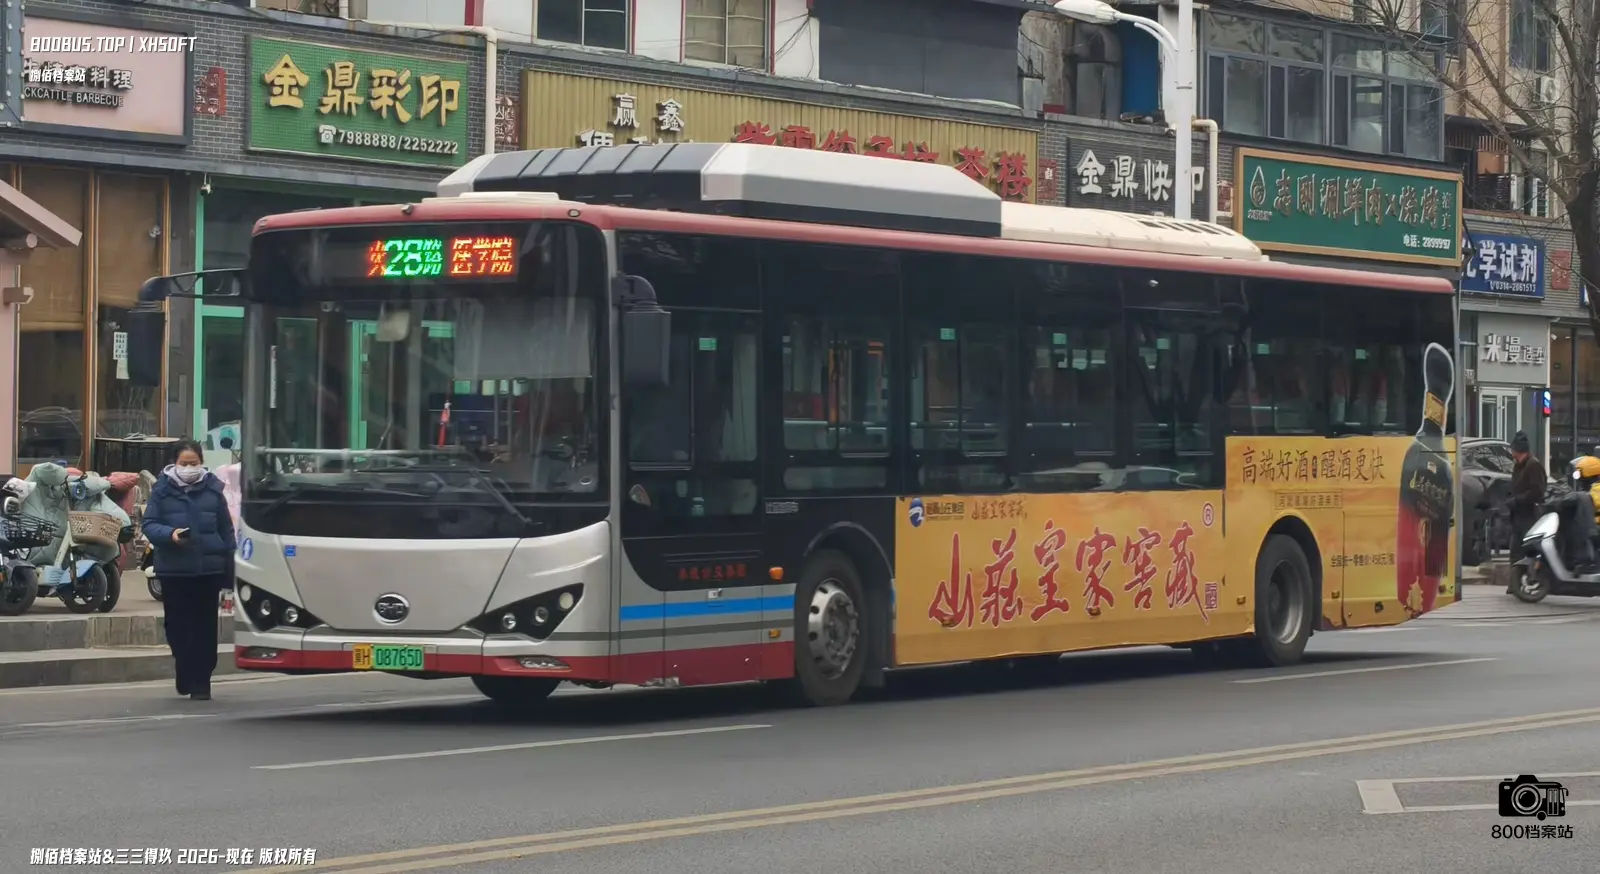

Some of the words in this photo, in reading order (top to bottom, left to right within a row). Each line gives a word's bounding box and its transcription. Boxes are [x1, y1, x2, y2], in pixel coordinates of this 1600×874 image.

[77, 92, 124, 107] BARBECUE
[264, 53, 461, 126] 金鼎彩印
[613, 93, 685, 132] 赢鑫
[339, 129, 459, 154] 7988888/2252222
[451, 236, 513, 275] 医学院
[1242, 446, 1308, 484] 高端好酒
[1321, 447, 1385, 481] 醒酒更快
